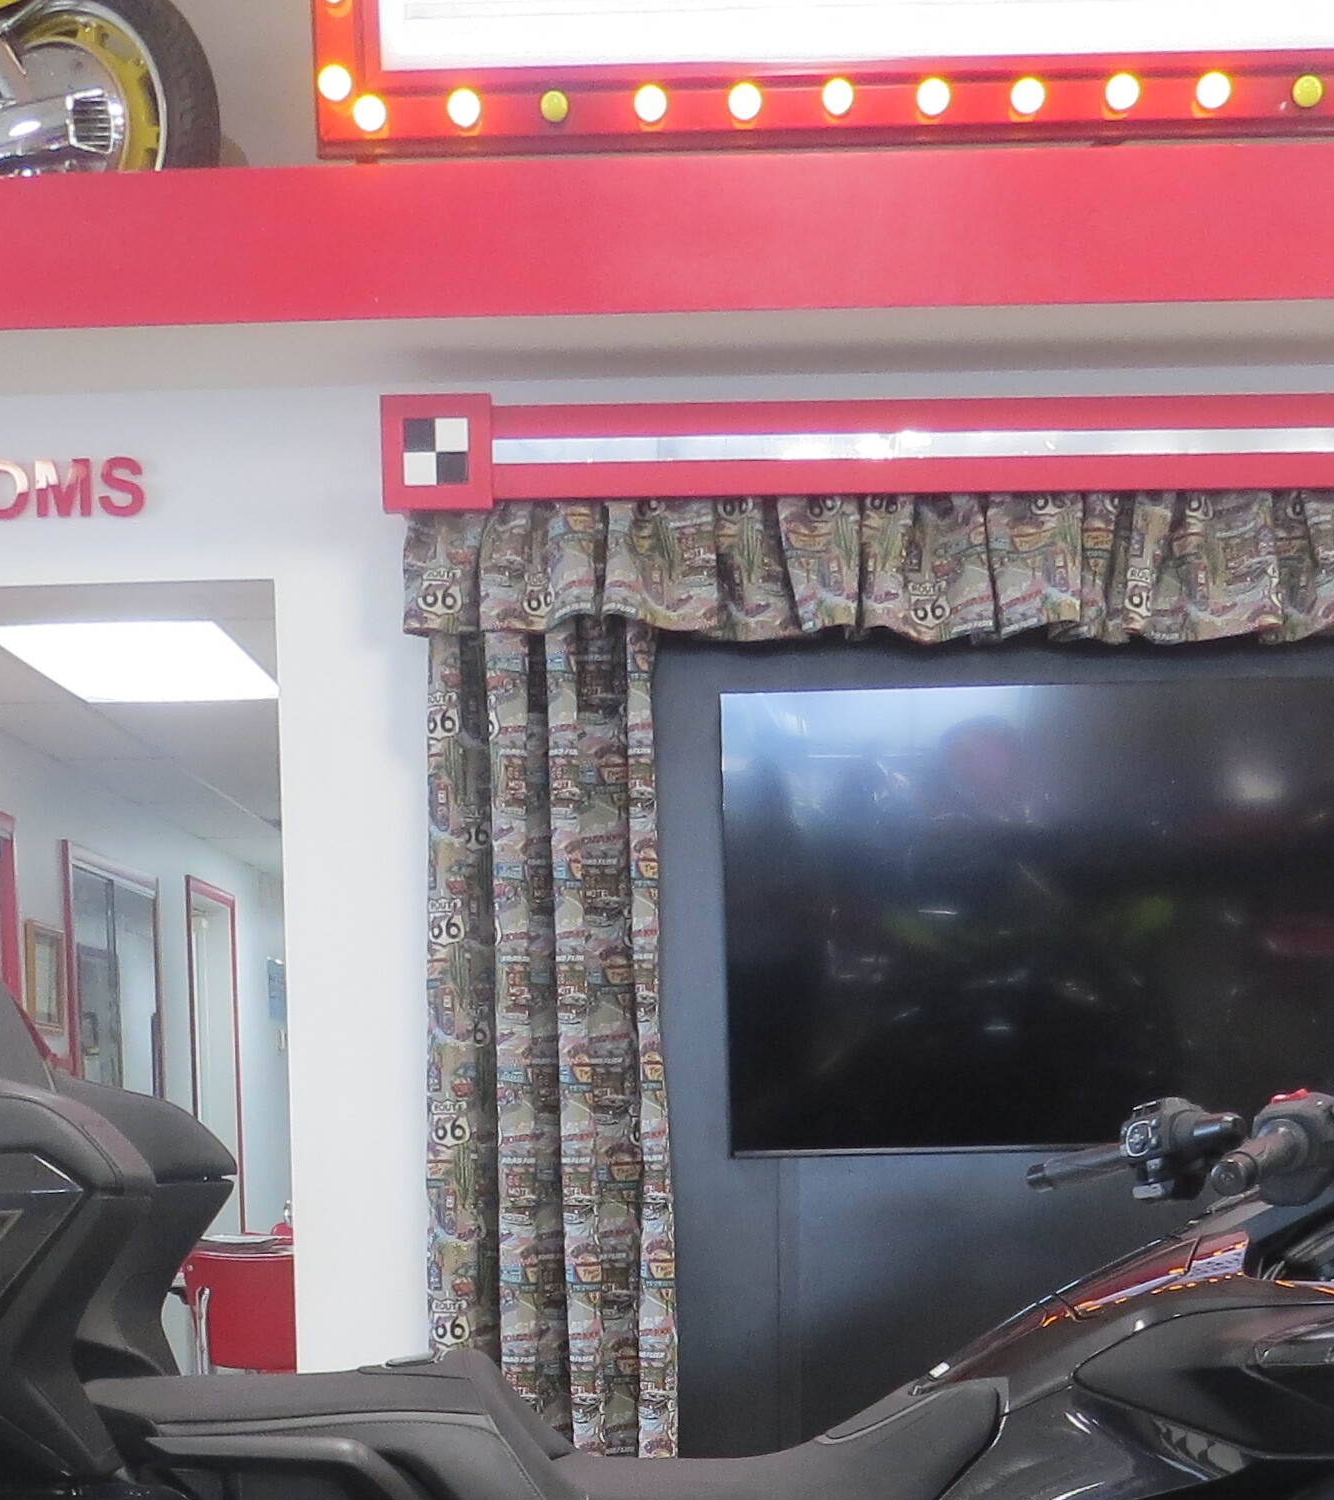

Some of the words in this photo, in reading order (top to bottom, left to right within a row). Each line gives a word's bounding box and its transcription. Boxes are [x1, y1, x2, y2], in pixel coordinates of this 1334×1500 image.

[433, 1101, 465, 1113] ROUTE
[434, 1116, 466, 1142] 66
[435, 1301, 464, 1312] ROUTE
[434, 1314, 466, 1341] 66
